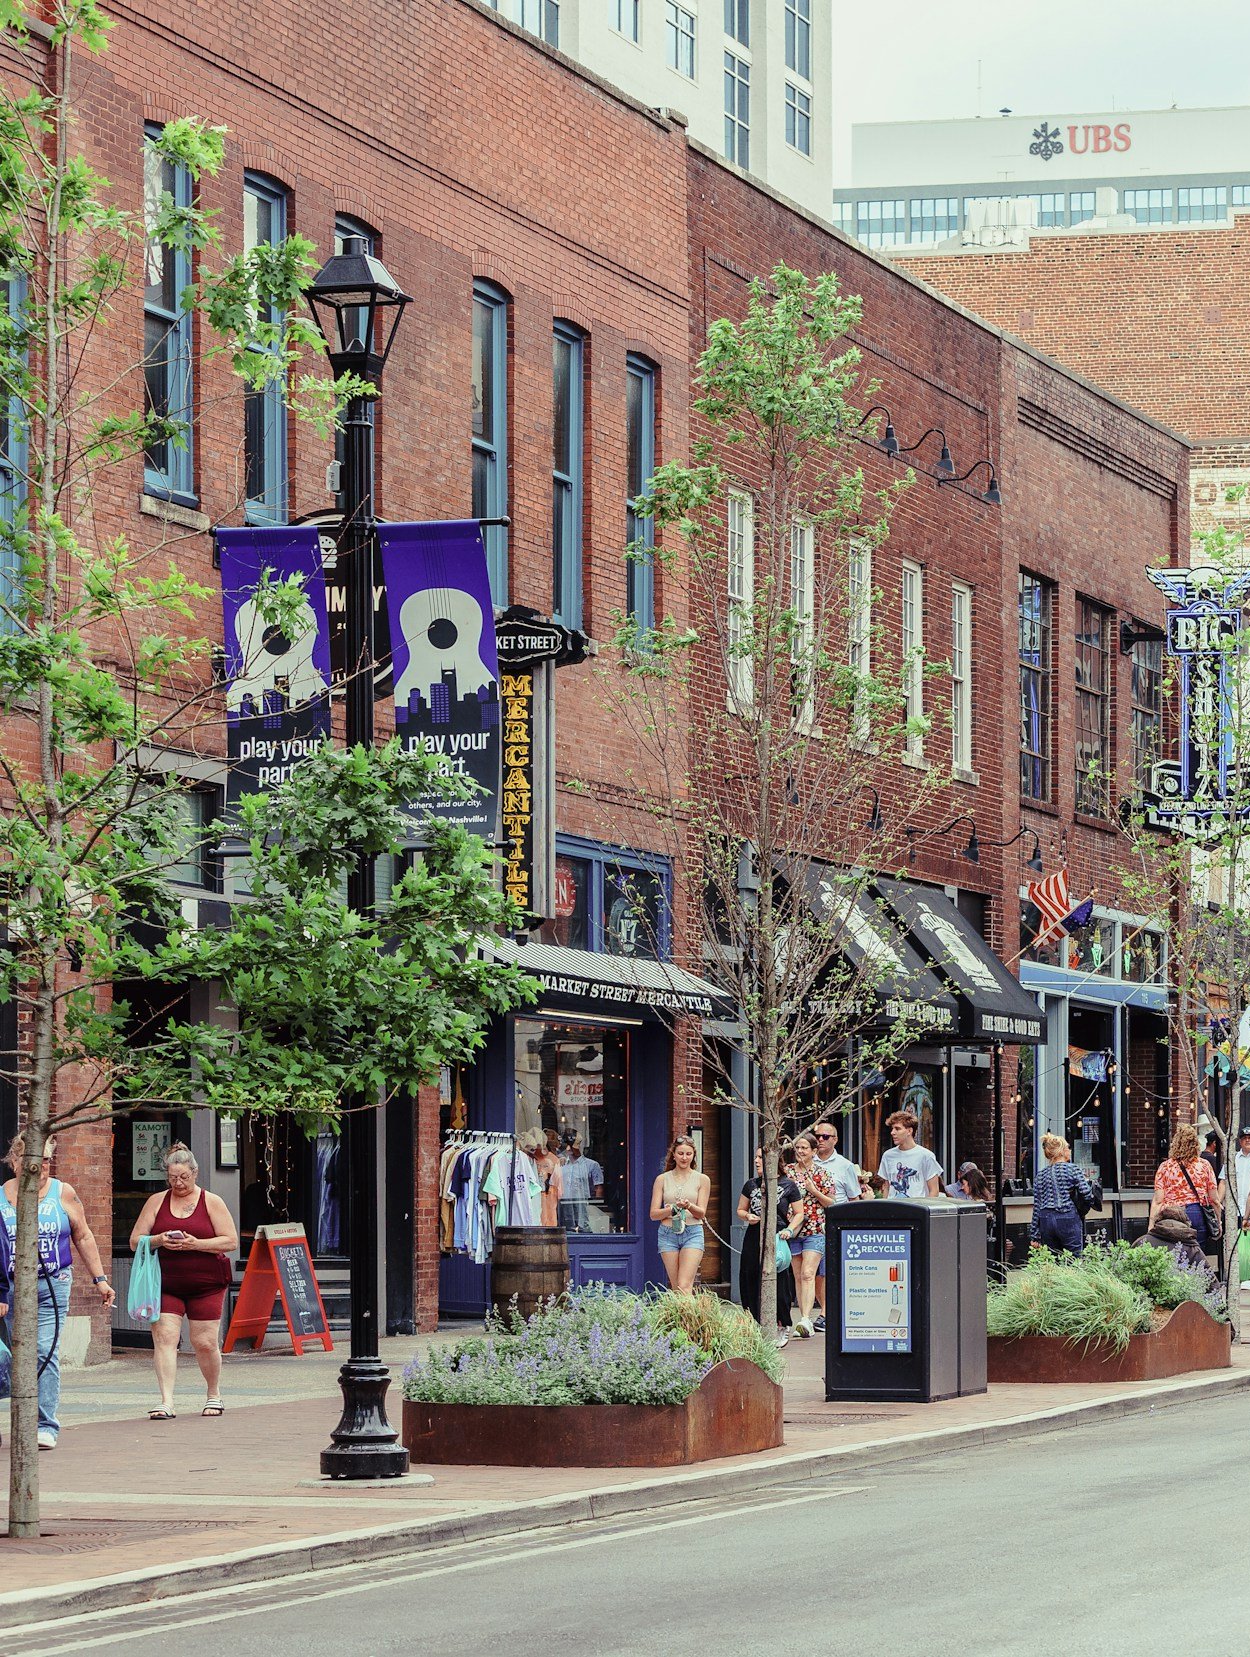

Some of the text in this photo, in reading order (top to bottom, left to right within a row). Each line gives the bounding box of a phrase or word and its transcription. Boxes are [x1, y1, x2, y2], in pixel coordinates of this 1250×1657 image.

[1067, 123, 1131, 155] UBS
[496, 634, 556, 650] KET STREET
[1175, 616, 1232, 649] BIG
[240, 737, 321, 762] play your
[449, 732, 490, 756] your
[258, 763, 295, 788] part
[501, 674, 533, 906] MERCANTILE
[408, 801, 434, 810] others,
[436, 800, 450, 808] and
[467, 799, 482, 809] city.
[449, 815, 488, 824] Nashville!
[539, 974, 713, 1011] MARKET STREET MERCANTILE
[1027, 1020, 1040, 1037] EATS
[847, 1234, 906, 1243] NASHVILLE
[861, 1245, 906, 1253] RECYCLES
